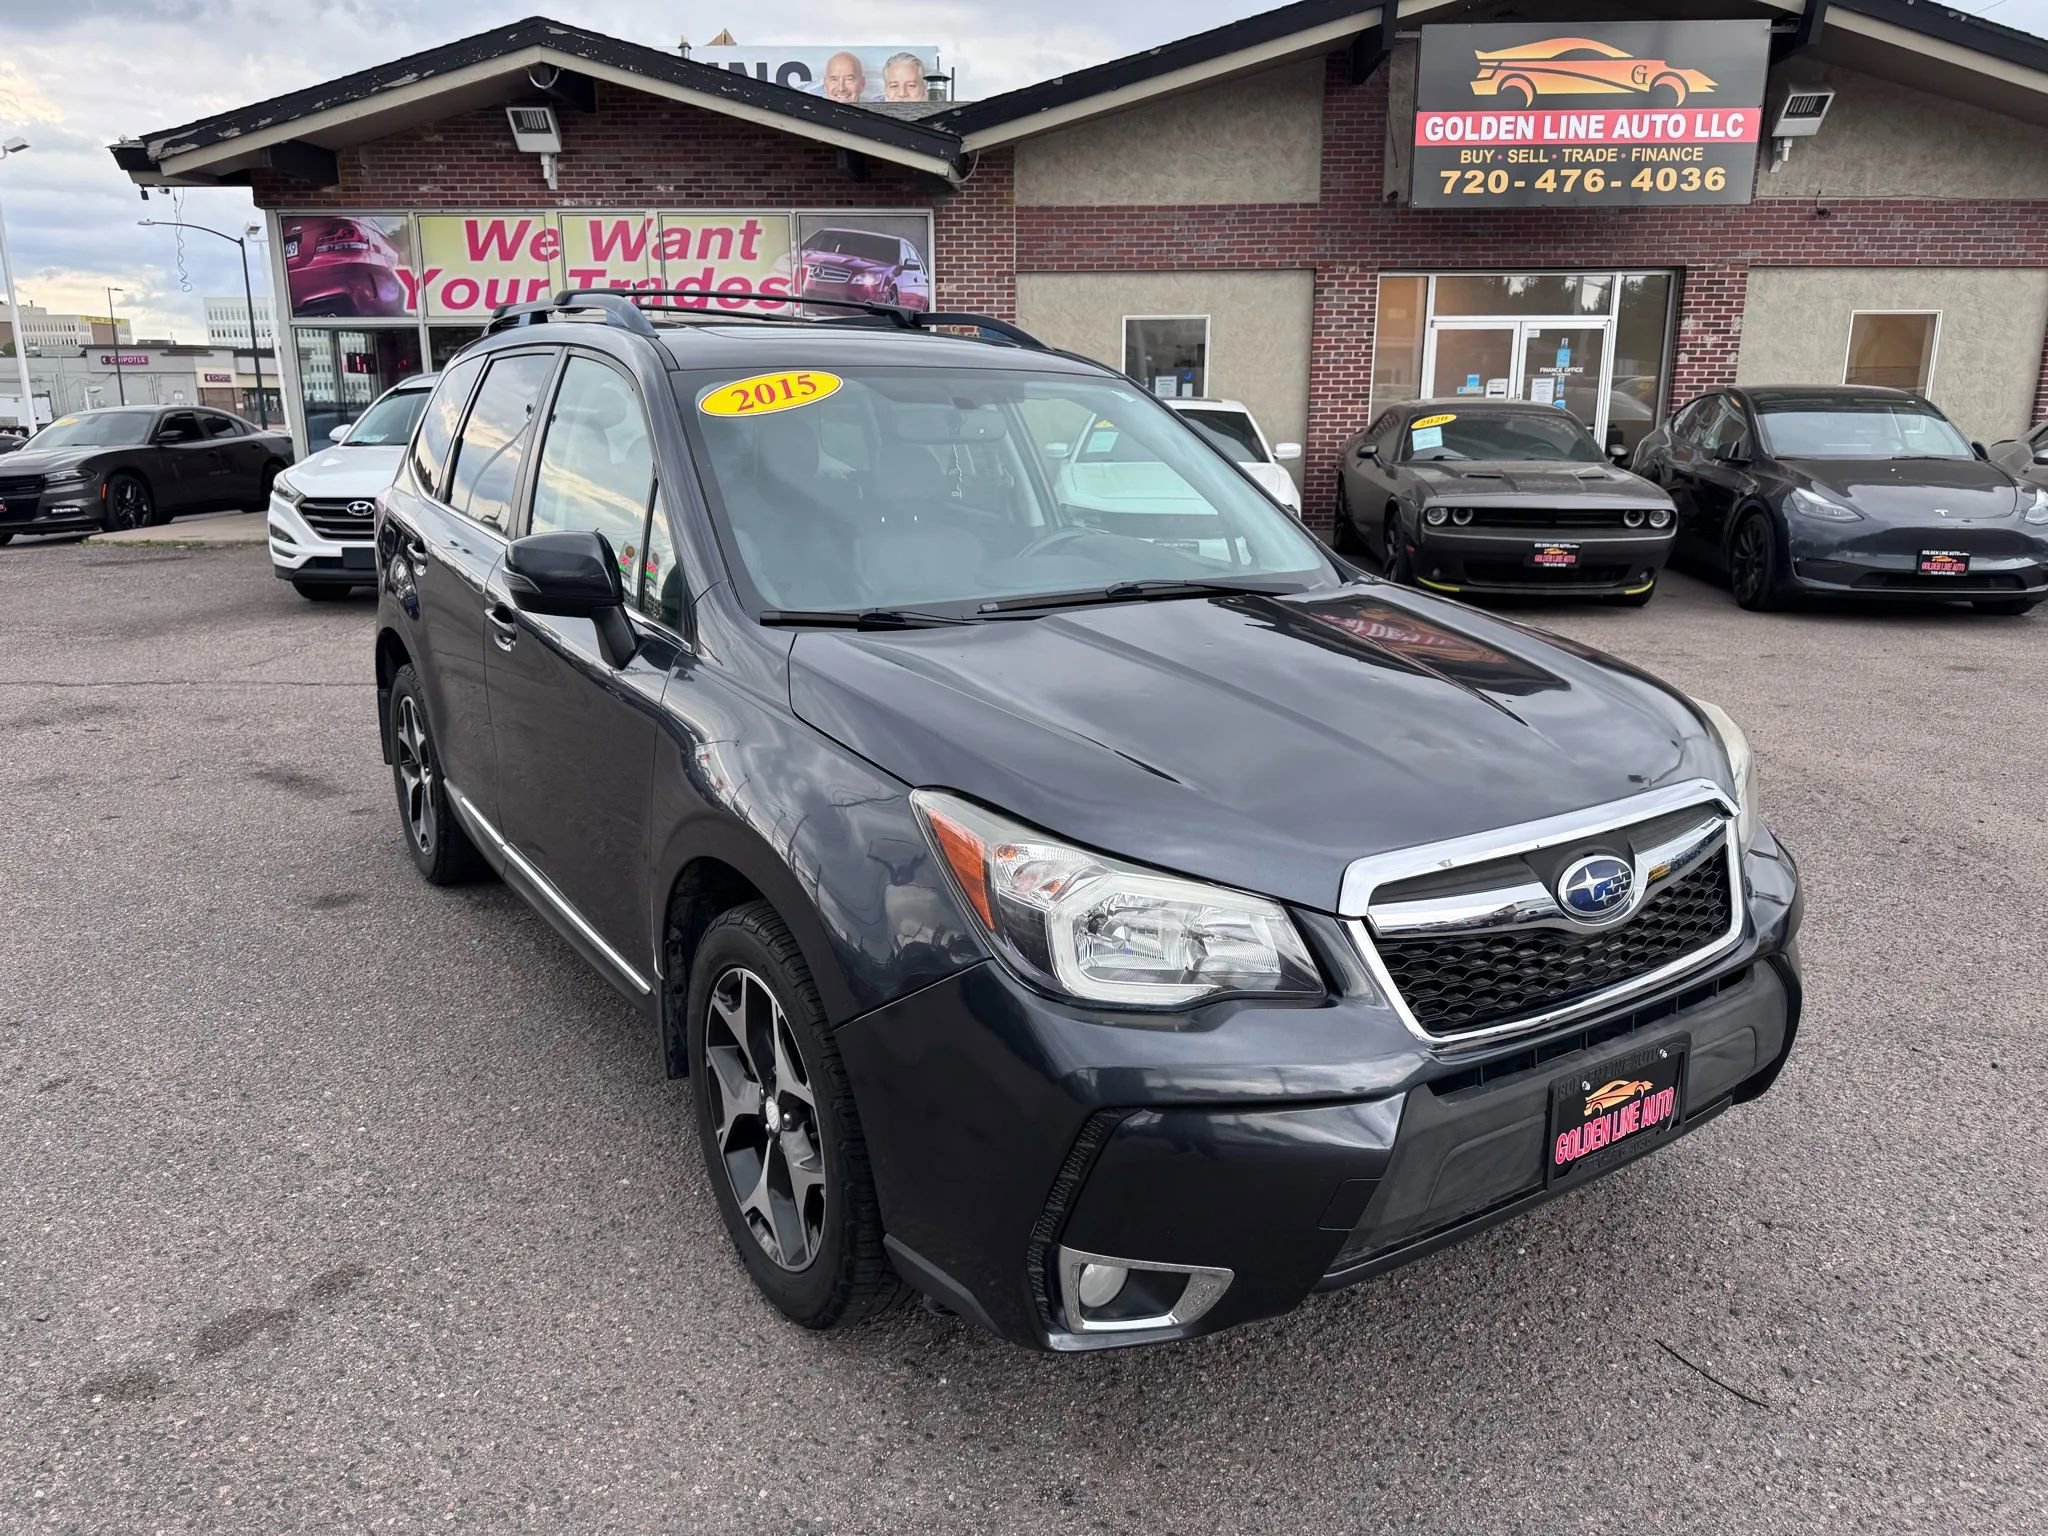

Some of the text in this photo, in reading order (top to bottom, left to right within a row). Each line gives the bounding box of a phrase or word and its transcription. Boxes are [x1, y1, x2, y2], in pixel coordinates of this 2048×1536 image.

[1425, 112, 1745, 141] GOLDEN LINE AUTO LLC
[1460, 146, 1704, 164] BUY SELL TRADE FINANCE
[464, 218, 763, 262] We Want
[395, 268, 551, 311] Your
[731, 374, 817, 412] 2015
[1555, 1113, 1612, 1164] GOLDEN
[1611, 1100, 1640, 1142] LINE
[1641, 1086, 1675, 1129] AUTO
